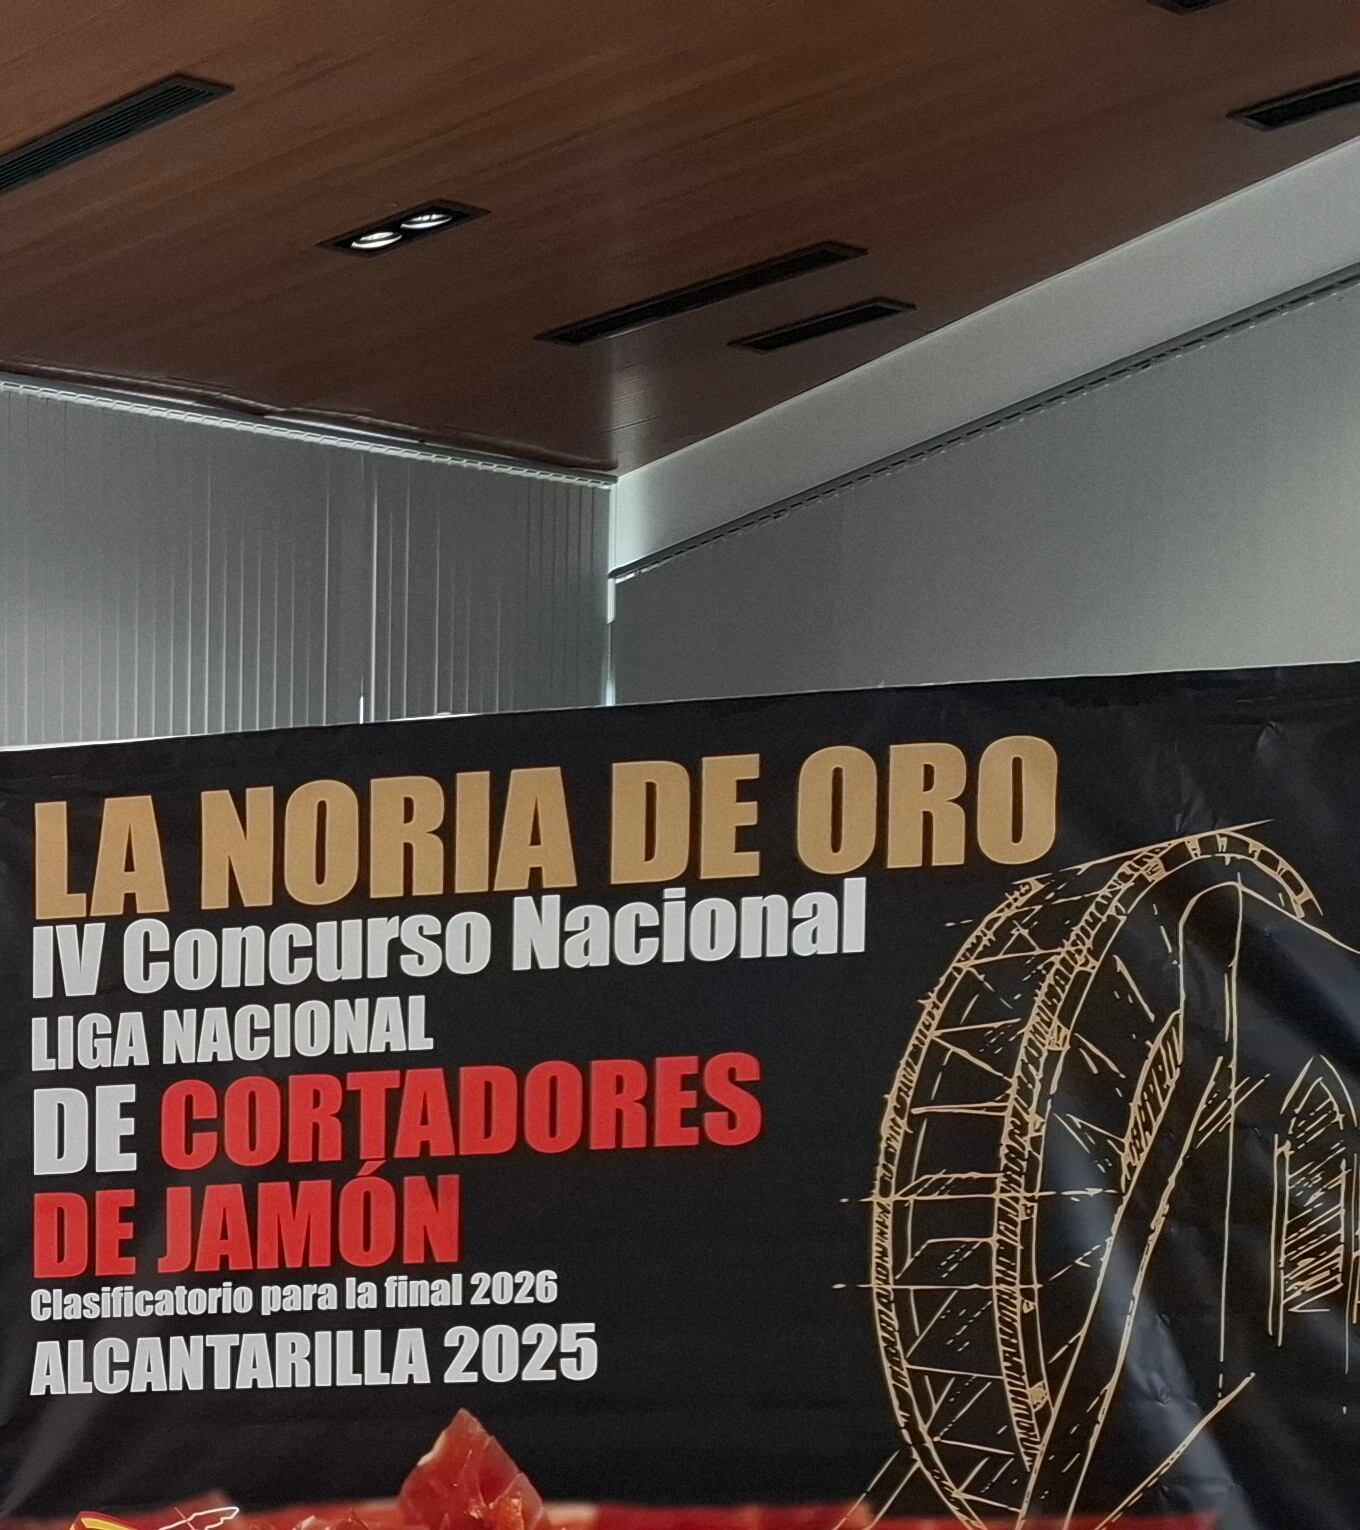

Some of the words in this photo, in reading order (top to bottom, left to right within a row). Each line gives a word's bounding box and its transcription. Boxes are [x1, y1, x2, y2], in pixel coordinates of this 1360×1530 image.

[34, 795, 170, 920] LA
[201, 766, 577, 909] NORIA
[611, 753, 761, 885] DE
[797, 735, 1059, 875] ORO
[32, 922, 106, 998] IV
[123, 910, 491, 994] Concurso
[511, 877, 866, 971] Nacional
[31, 1011, 149, 1072] LIGA
[162, 995, 434, 1065] NACIONAL
[31, 1083, 137, 1176] DE
[160, 1051, 762, 1170] CORTADORES
[31, 1187, 135, 1279] DE
[157, 1160, 461, 1275] JAMÓN
[30, 1282, 253, 1323] Clasificatorio
[261, 1282, 338, 1317] para
[344, 1275, 378, 1309] la
[385, 1272, 463, 1308] final
[469, 1270, 558, 1306] 2026
[30, 1327, 431, 1396] ALCANTARILLA
[443, 1323, 598, 1385] 2025
